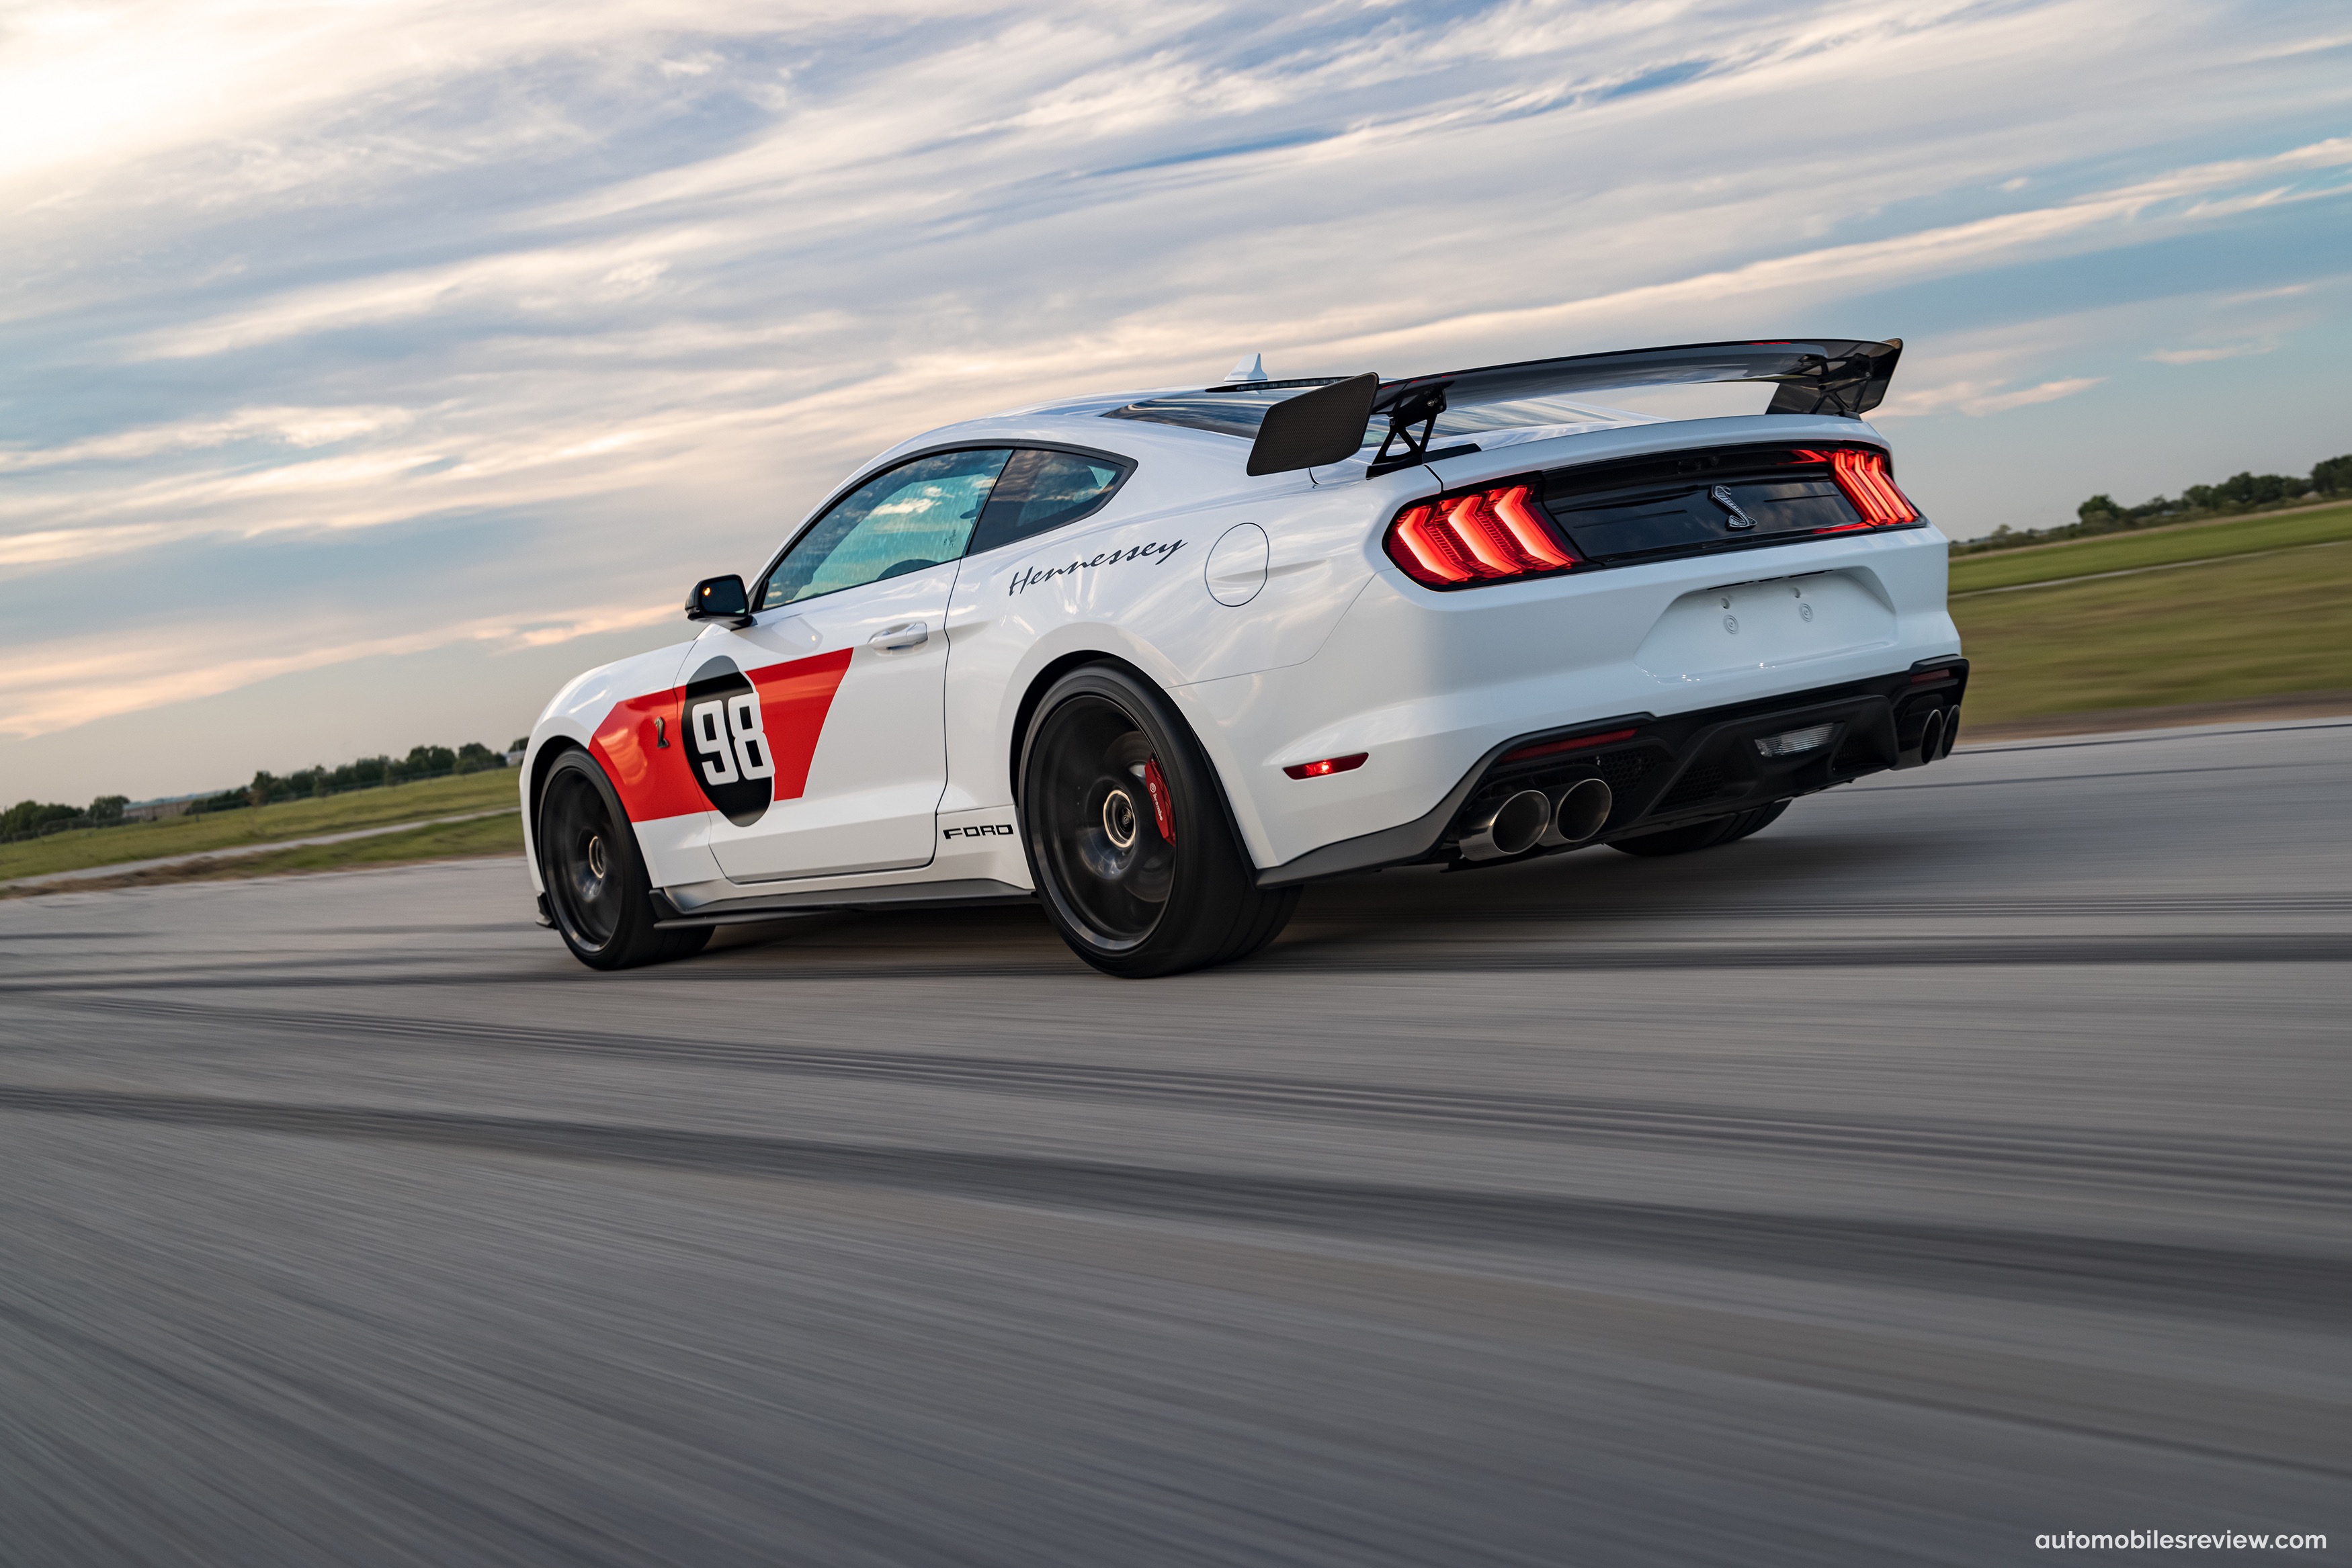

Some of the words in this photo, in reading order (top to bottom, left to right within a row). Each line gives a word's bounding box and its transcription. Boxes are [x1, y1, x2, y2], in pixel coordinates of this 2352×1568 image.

[1009, 539, 1188, 596] Hennessey
[692, 691, 775, 786] 98
[1152, 793, 1163, 821] brembo
[943, 824, 1014, 840] FORD
